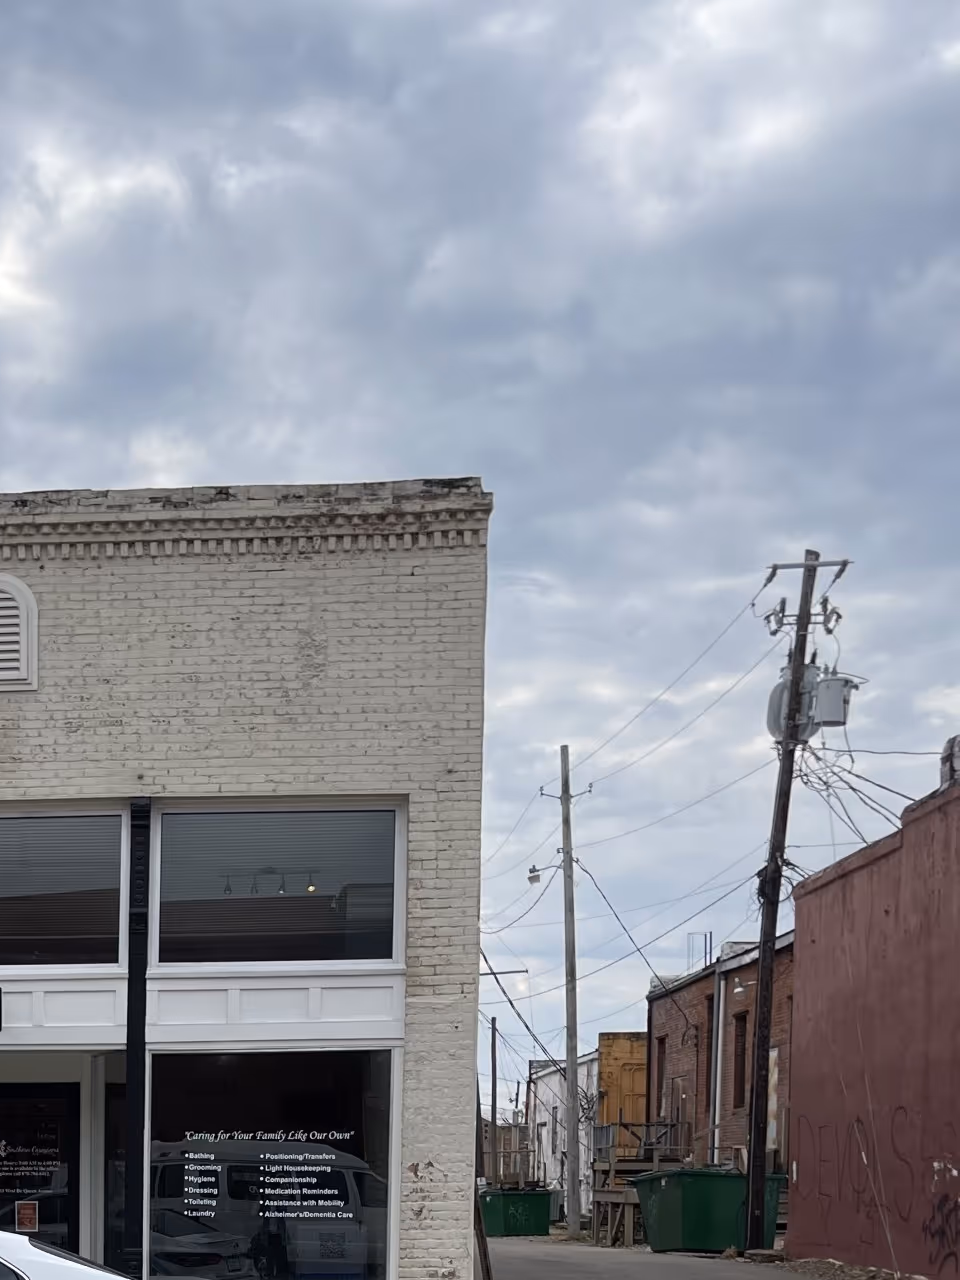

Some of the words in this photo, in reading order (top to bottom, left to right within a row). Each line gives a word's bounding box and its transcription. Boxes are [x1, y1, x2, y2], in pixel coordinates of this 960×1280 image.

[214, 1131, 230, 1142] for
[232, 1131, 253, 1140] Your
[256, 1131, 286, 1142] Family
[285, 1130, 307, 1141] Like
[309, 1131, 326, 1140] Our
[328, 1131, 355, 1140] Own"
[189, 1164, 221, 1172] Grooming
[284, 1165, 331, 1173] Housekeeping
[265, 1176, 317, 1184] Companionship
[189, 1210, 215, 1218] Laundry
